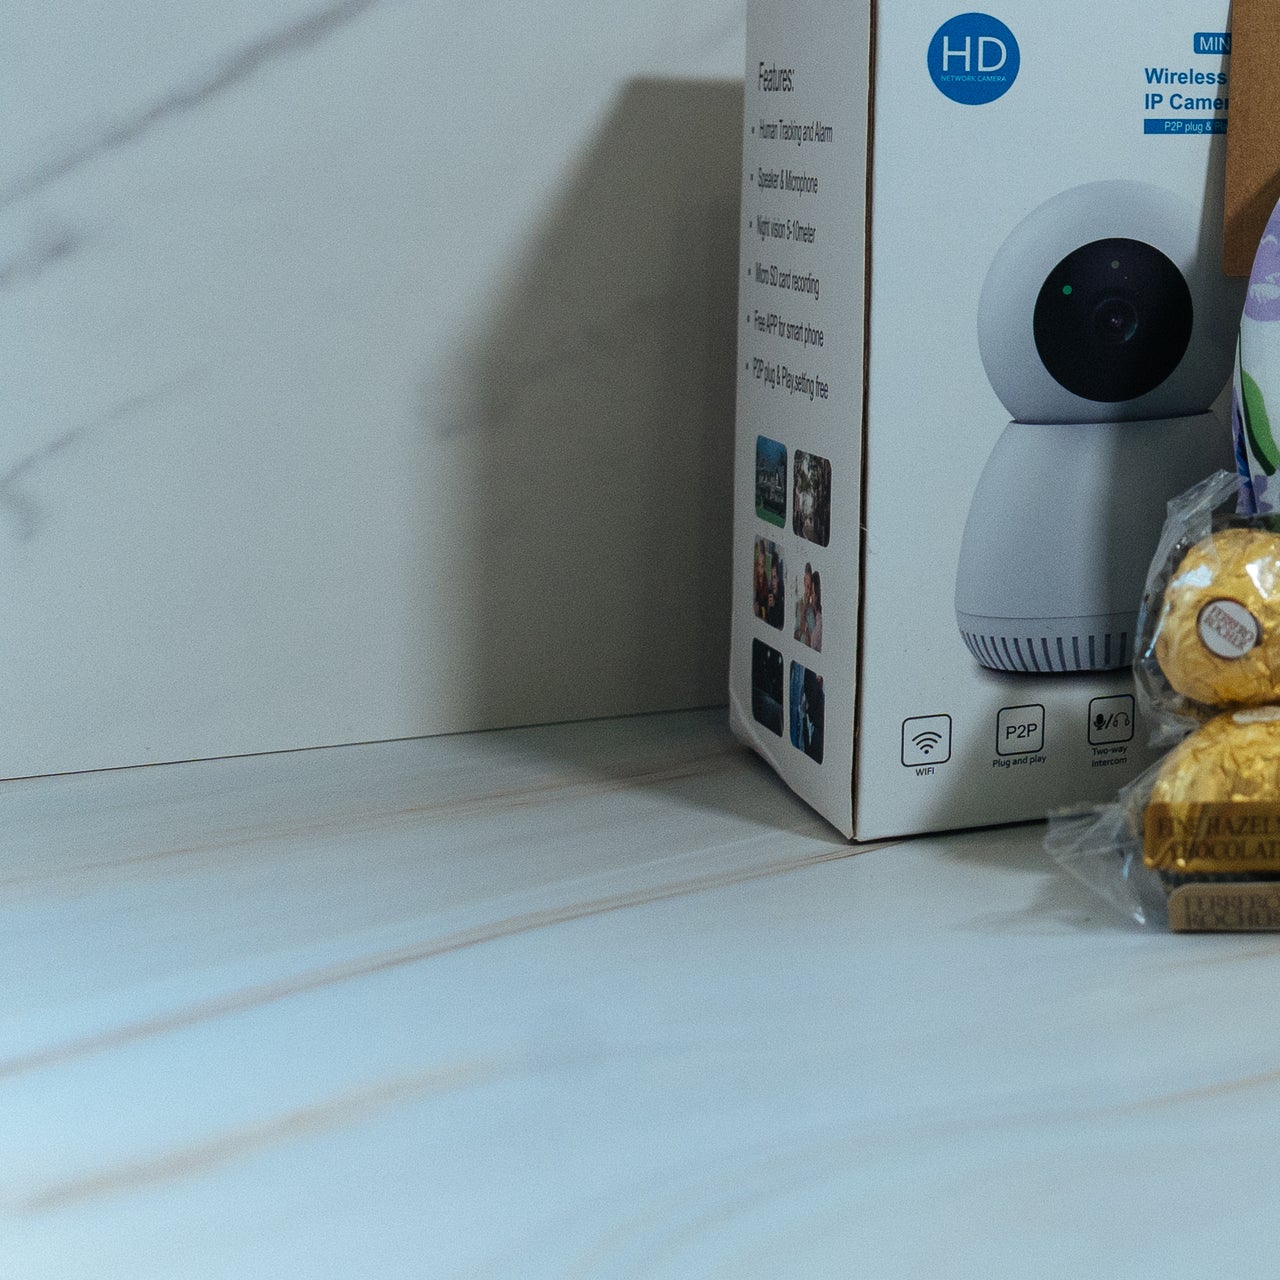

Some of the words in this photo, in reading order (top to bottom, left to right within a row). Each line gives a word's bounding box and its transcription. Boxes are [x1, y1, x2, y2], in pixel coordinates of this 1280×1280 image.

[1199, 36, 1231, 51] MIN
[942, 36, 1007, 72] HD
[758, 61, 795, 92] Features:
[977, 75, 1007, 83] CAMERA
[1144, 67, 1227, 85] Wireless
[1144, 93, 1164, 110] IP
[803, 121, 815, 141] and
[1164, 121, 1183, 132] P2P
[1184, 121, 1204, 134] plug
[1205, 121, 1212, 131] &
[770, 265, 778, 287] SD
[779, 269, 791, 289] card
[792, 272, 820, 301] recording
[787, 322, 803, 342] smart
[804, 322, 824, 349] phone
[815, 375, 829, 400] free
[1005, 722, 1039, 740] P2P
[1091, 745, 1129, 756] Two-way
[992, 757, 1011, 768] Plug
[1012, 756, 1029, 766] and
[1031, 754, 1048, 766] play
